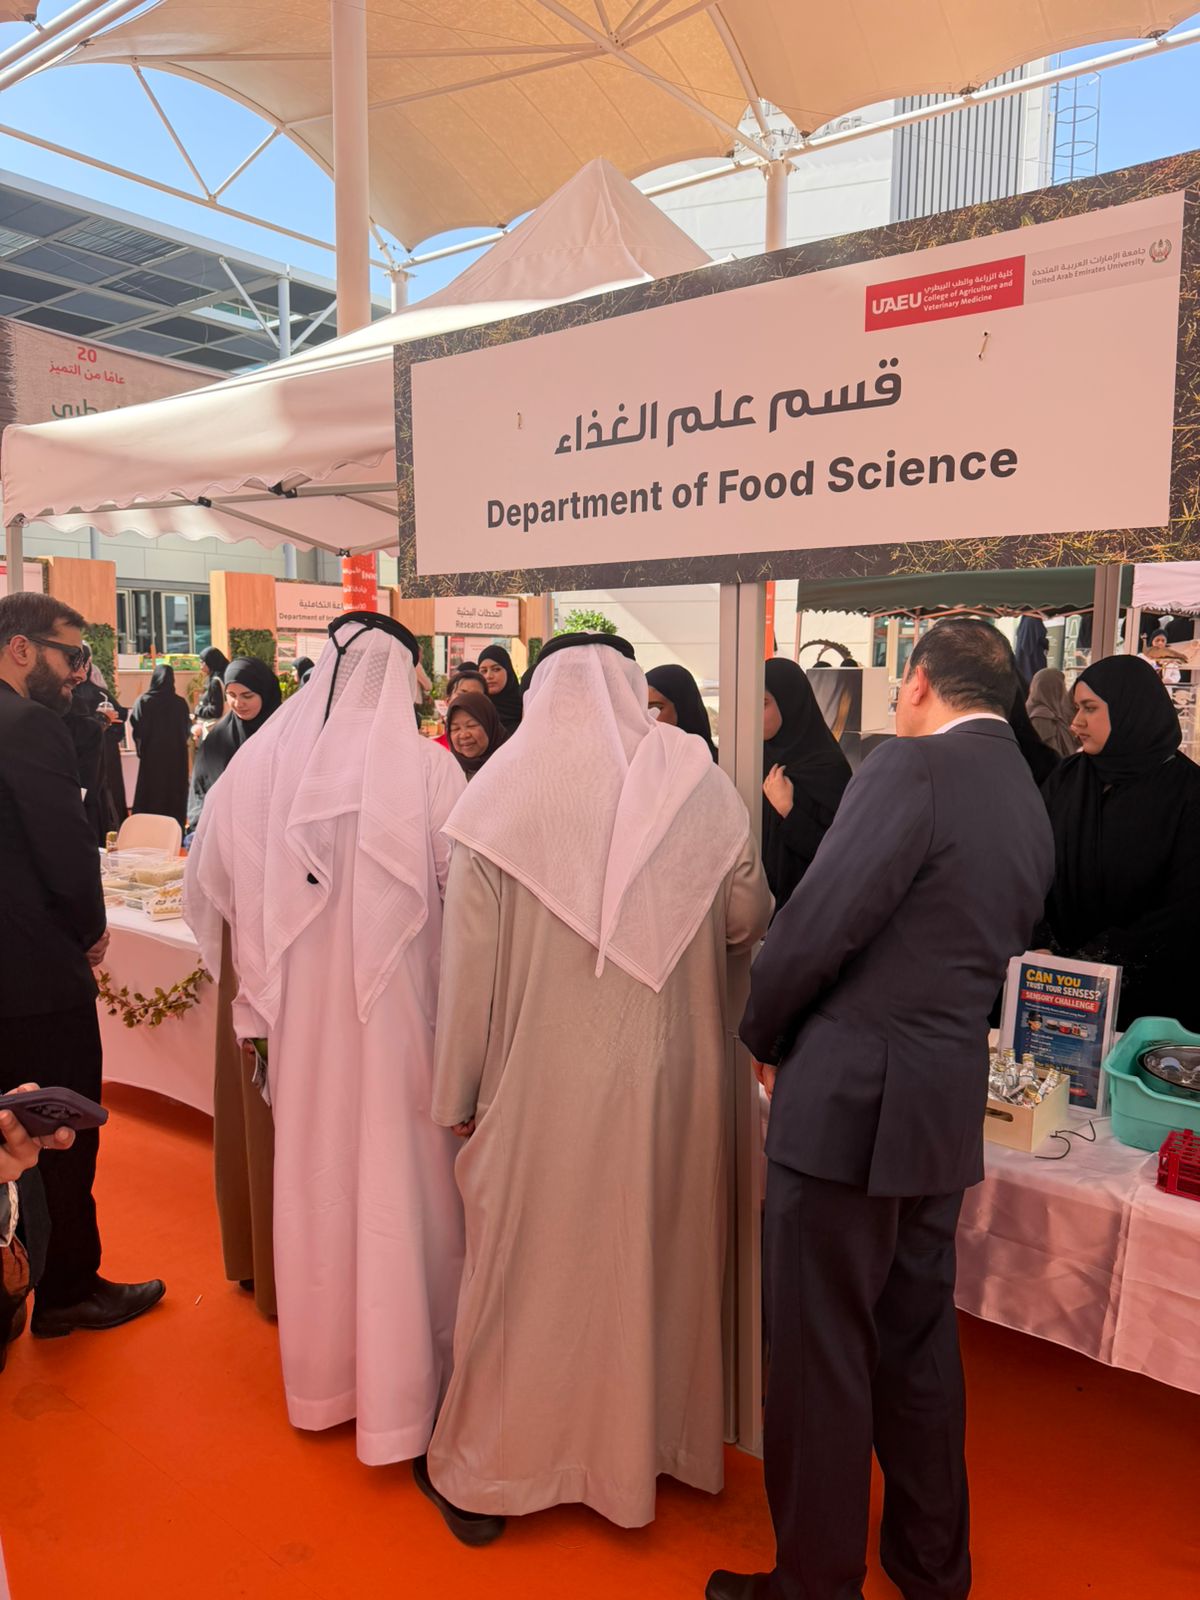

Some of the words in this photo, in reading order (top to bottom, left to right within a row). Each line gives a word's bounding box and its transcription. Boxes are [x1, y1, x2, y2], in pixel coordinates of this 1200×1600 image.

[1089, 252, 1120, 264] الإمارات
[1122, 248, 1146, 258] جامعة
[1031, 274, 1055, 286] United
[1056, 270, 1073, 281] Arab
[1074, 265, 1106, 278] Emirates
[1107, 257, 1146, 271] University
[1032, 265, 1059, 276] المتحدة
[1061, 259, 1088, 271] العربية
[952, 277, 974, 288] والطب
[975, 272, 997, 284] الزراعة
[998, 269, 1014, 280] كلية
[923, 292, 949, 303] College
[950, 289, 958, 298] of
[959, 283, 998, 297] Agriculture
[999, 280, 1013, 289] and
[924, 282, 951, 294] البيطري
[872, 292, 922, 315] UAEU
[923, 300, 960, 312] Veterinary
[960, 294, 993, 305] Medicine
[77, 346, 98, 364] 20
[49, 360, 81, 376] التميز
[84, 368, 102, 381] من
[768, 357, 901, 433] قسم
[667, 389, 756, 447] علم
[554, 401, 658, 454] الغذاء
[487, 481, 662, 532] Department
[672, 471, 708, 509] of
[719, 460, 814, 504] Food
[827, 449, 1018, 493] Science
[279, 613, 317, 621] Department
[456, 620, 483, 629] Research
[484, 621, 504, 630] station
[1026, 969, 1052, 983] CAN
[1056, 975, 1081, 987] YOU
[1026, 981, 1044, 990] TRUST
[1045, 984, 1062, 993] YOUR
[1063, 987, 1100, 1000] SENSES?
[1026, 992, 1054, 1002] SENSORY
[1055, 996, 1095, 1010] CHALLENGE
